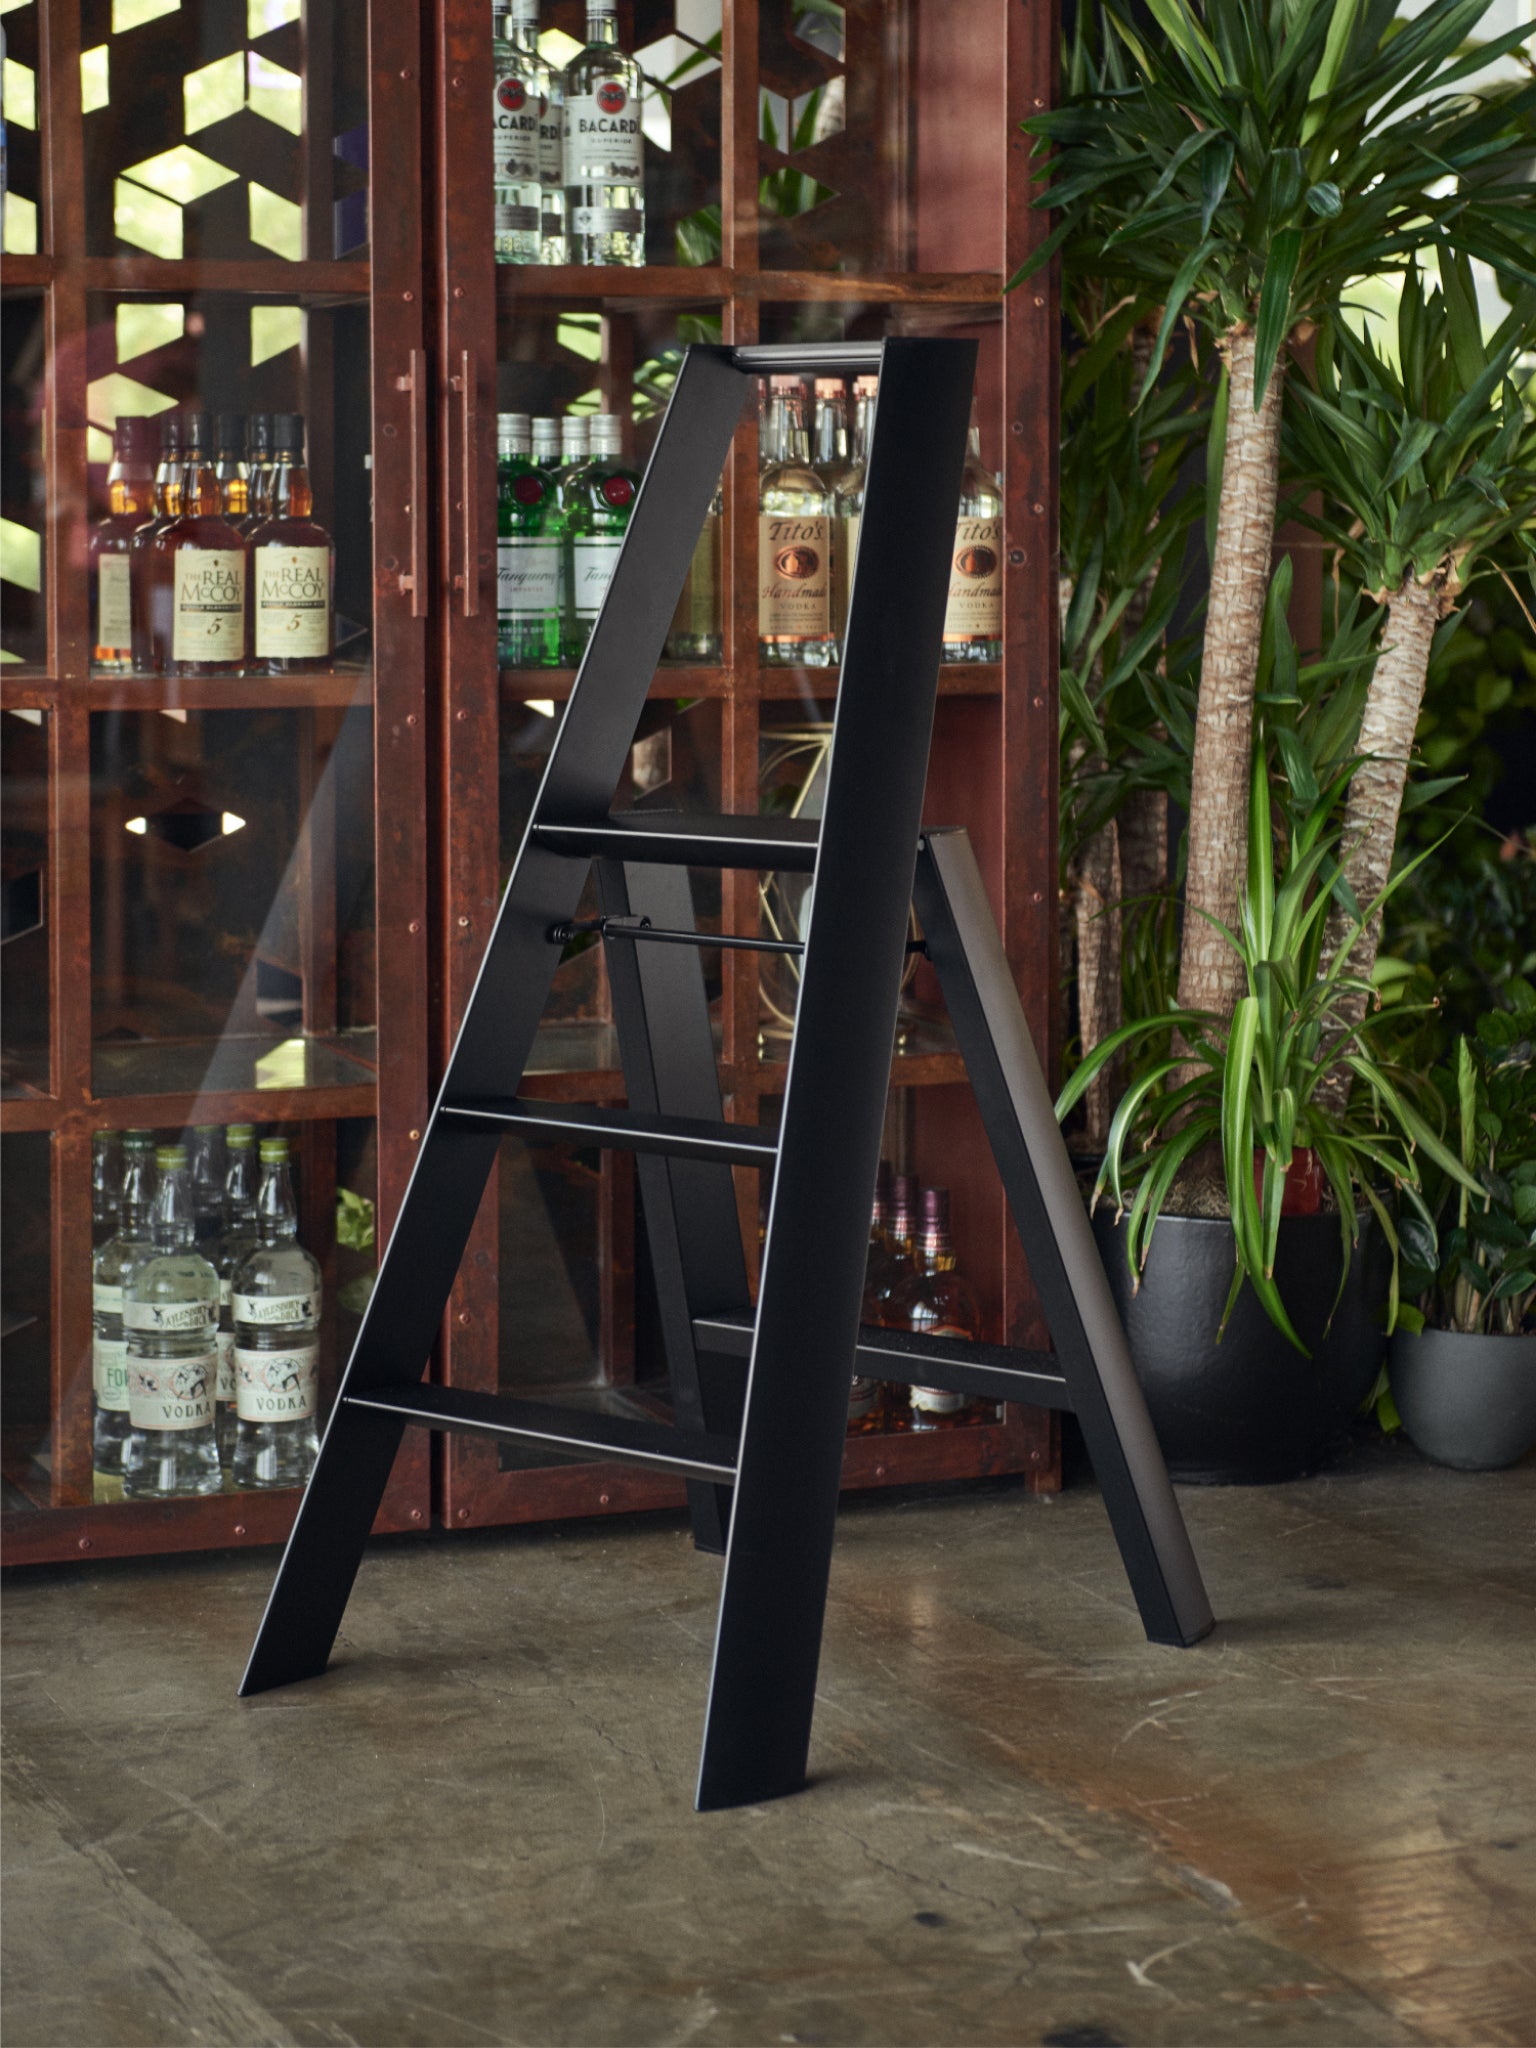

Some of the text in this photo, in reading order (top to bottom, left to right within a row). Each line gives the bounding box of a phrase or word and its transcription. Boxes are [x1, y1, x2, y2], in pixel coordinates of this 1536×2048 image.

[768, 520, 823, 542] Tito's
[203, 570, 240, 585] REAL
[281, 567, 324, 583] REAL
[206, 617, 223, 635] 5
[286, 613, 303, 632] 5
[162, 1401, 212, 1419] VODKA
[256, 1395, 307, 1411] VODKA
